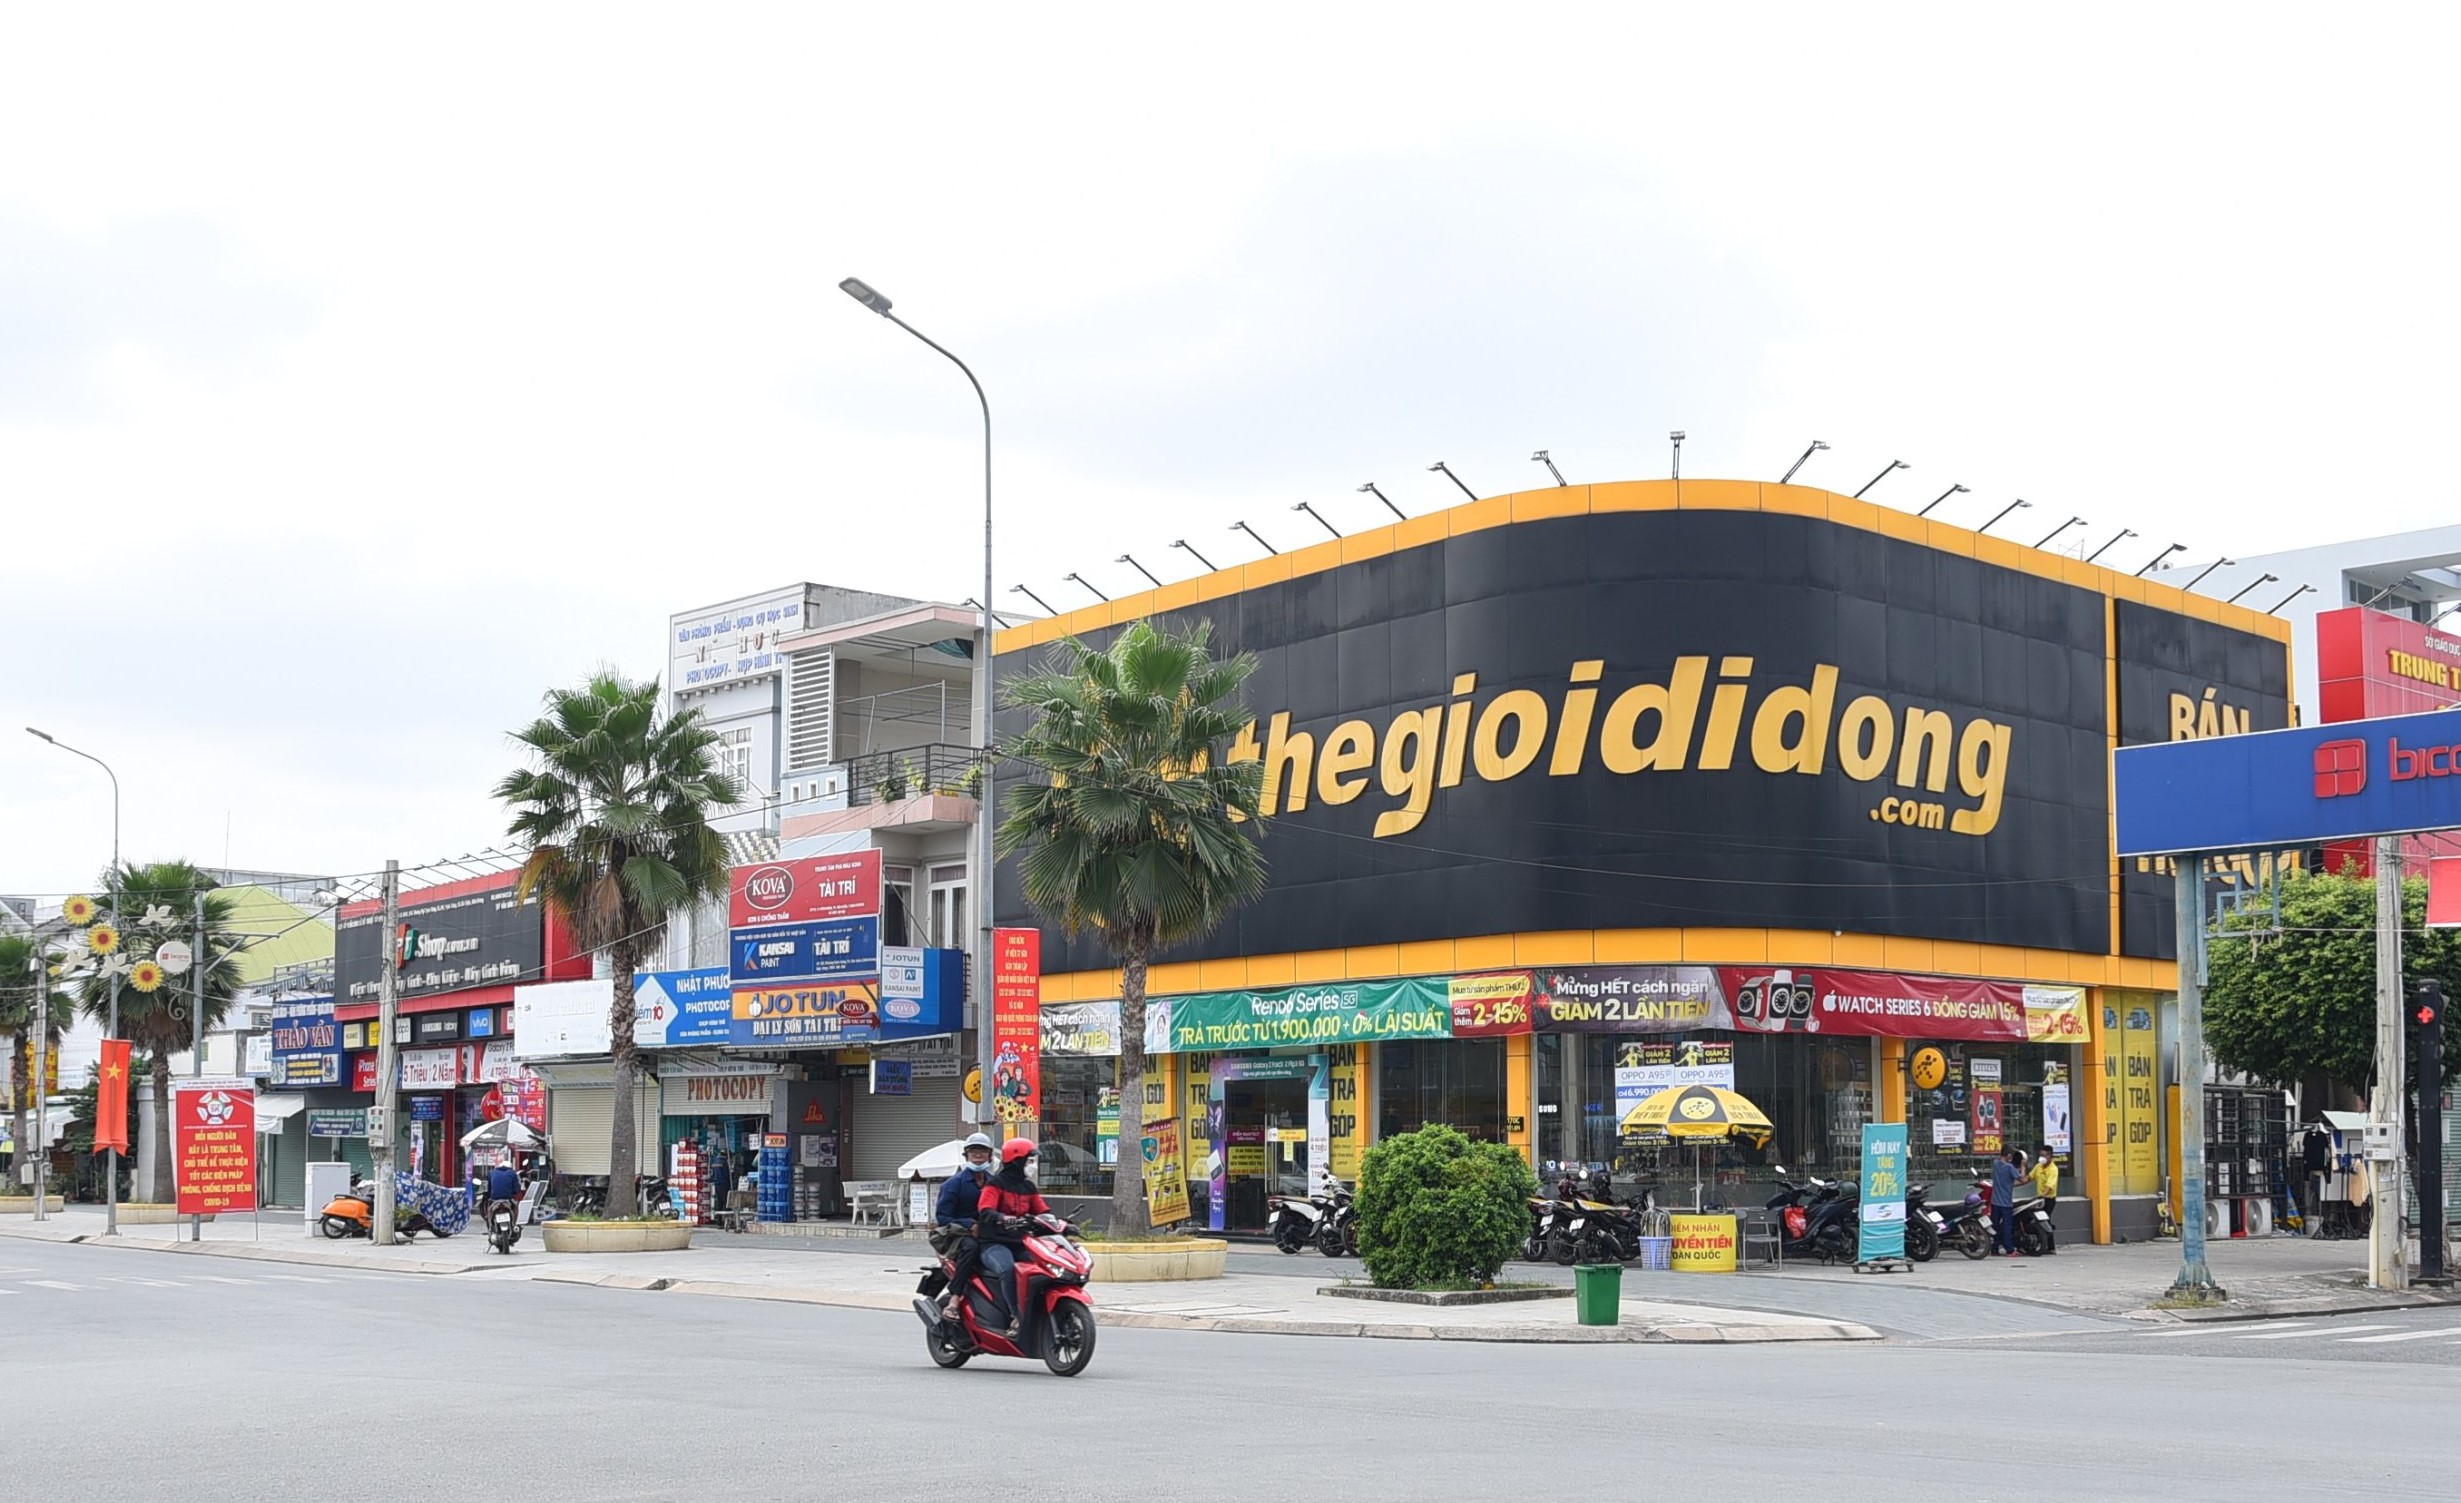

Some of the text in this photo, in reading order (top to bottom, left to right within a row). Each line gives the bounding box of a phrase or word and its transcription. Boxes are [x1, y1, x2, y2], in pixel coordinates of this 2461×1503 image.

[2386, 649, 2448, 688] TRUNG
[2168, 687, 2249, 743] BÁN
[1225, 656, 2010, 838] thegioididong
[752, 877, 786, 896] KOVA
[819, 875, 857, 898] TÀI TRÍ
[759, 941, 795, 957] KANSAI
[814, 935, 851, 956] TÀI TRÍ
[760, 957, 780, 970] PAINT
[892, 954, 920, 963] JOTUN
[676, 974, 701, 996] NHẬT
[906, 985, 921, 993] PAINT
[1556, 975, 1708, 999] Mừng HẾT cách ngăn
[763, 990, 846, 1015] JOTUN
[843, 1002, 865, 1013] KOVA
[889, 1002, 915, 1015] KOVA
[1296, 990, 1339, 1016] Series
[1454, 1001, 1527, 1026] Giảm 2-15%
[1550, 994, 1710, 1021] GIẢM 2 LẦN TIỀN
[1838, 995, 2020, 1022] WATCH SERIES 6 ĐỒNG GIẢM 15%
[472, 1017, 488, 1029] vivo
[753, 1019, 771, 1039] ĐẠI
[784, 1017, 801, 1034] SƠN
[803, 1014, 821, 1033] TÀI
[1178, 1020, 1204, 1046] TRẢ
[1205, 1016, 1250, 1044] TRƯỚC
[1252, 1015, 1271, 1042] TỪ
[1272, 1015, 1340, 1042] 1.900.000
[1352, 1012, 1372, 1035] 0%
[1375, 1011, 1399, 1035] LÃI
[1400, 1003, 1444, 1033] SUẤT
[1454, 1015, 1473, 1027] thêm
[2045, 1013, 2083, 1035] 2-15%
[274, 1019, 308, 1050] THẢO
[1051, 1030, 1061, 1051] 2
[403, 1062, 455, 1083] 5 Triệu 2 Năm
[1680, 1069, 1725, 1081] OPPO A95
[2128, 1050, 2151, 1078] BÁN
[1308, 1054, 1329, 1100] Z
[1331, 1071, 1356, 1101] TRẢ
[1621, 1070, 1666, 1081] OPPO A95
[688, 1075, 766, 1101] PHOTOCOPY
[2128, 1081, 2152, 1109] TRẢ
[1331, 1109, 1356, 1139] GÓP
[2129, 1116, 2152, 1143] GÓP
[1870, 1139, 1902, 1155] HÔM NAY
[1984, 1136, 2002, 1151] 25%
[1870, 1171, 1899, 1197] 20%
[1692, 1221, 1721, 1234] NHẬN
[1706, 1233, 1733, 1249] TIỀN
[1693, 1249, 1721, 1261] QUỐC
